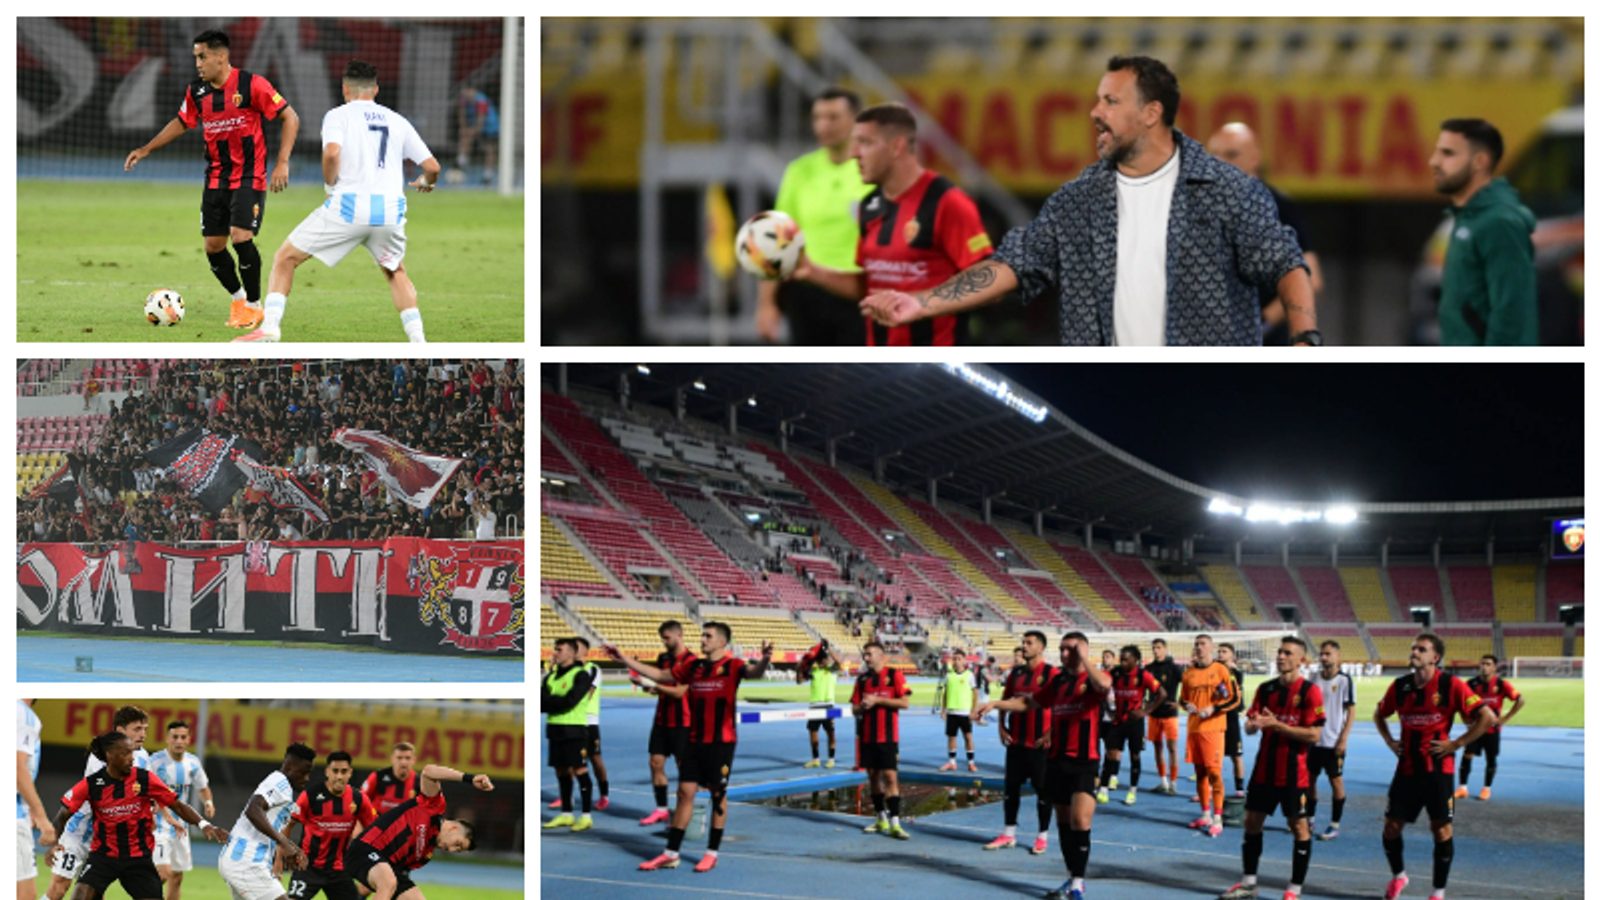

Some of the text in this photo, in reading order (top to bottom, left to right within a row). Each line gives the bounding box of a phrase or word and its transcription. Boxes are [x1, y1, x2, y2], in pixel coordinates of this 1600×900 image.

[368, 124, 389, 168] 7
[495, 570, 507, 586] 9
[458, 606, 499, 627] 8 7
[62, 854, 76, 871] 13
[288, 880, 306, 897] 32
